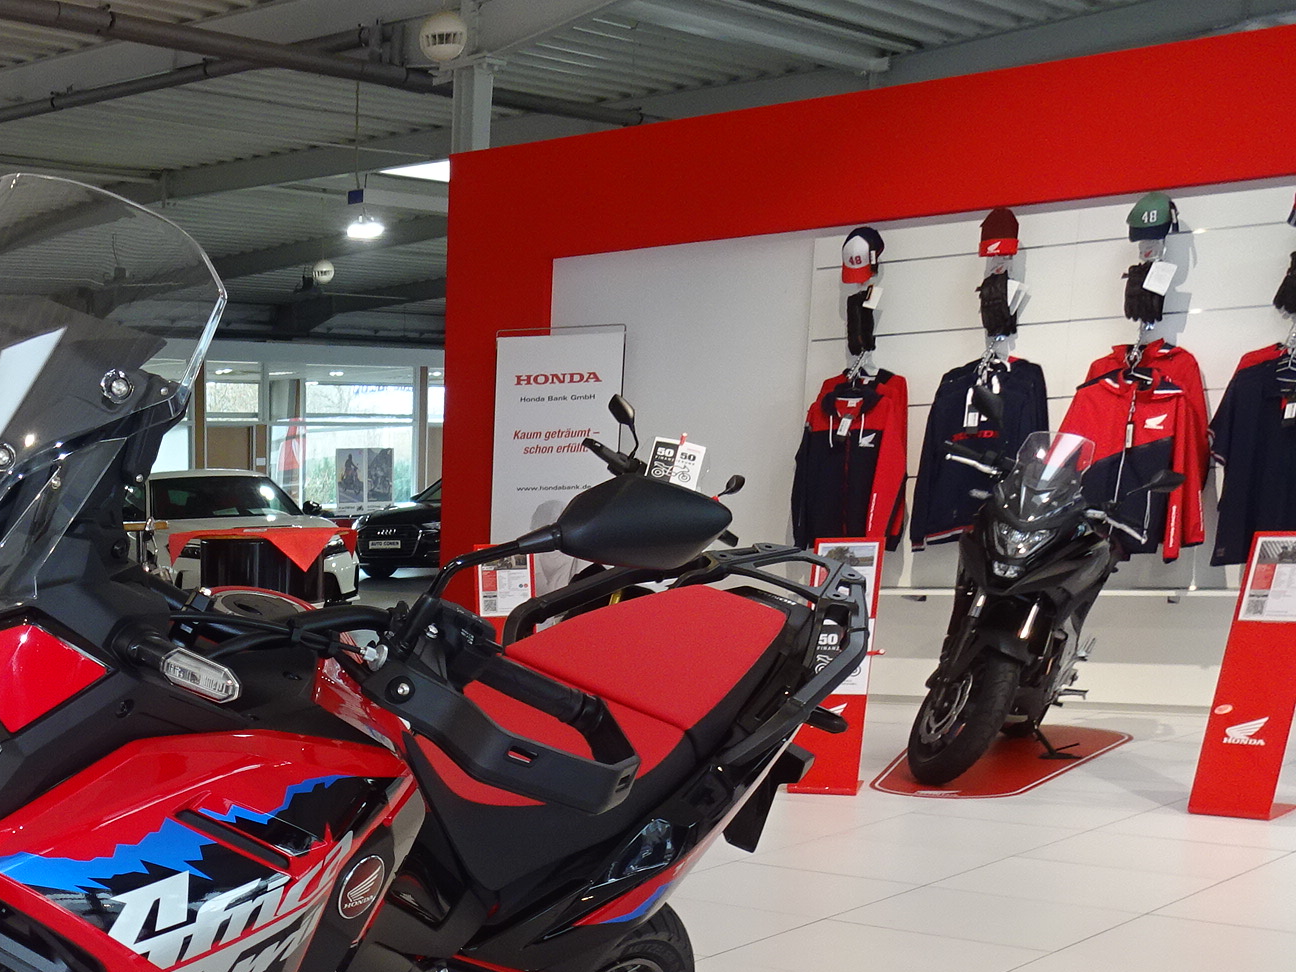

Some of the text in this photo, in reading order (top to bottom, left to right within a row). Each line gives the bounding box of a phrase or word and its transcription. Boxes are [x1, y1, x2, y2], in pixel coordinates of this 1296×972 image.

[1141, 210, 1158, 223] 48
[848, 255, 863, 265] 48
[514, 372, 602, 386] HONDA
[513, 430, 542, 440] Kaum
[544, 428, 591, 441] geträumt
[523, 444, 554, 454] schon
[656, 447, 696, 461] 50 50
[516, 484, 592, 492] www.hondabank.de
[818, 633, 839, 645] 50
[1222, 736, 1266, 746] HONDA
[108, 829, 354, 970] Africa
[343, 895, 376, 910] HONDA
